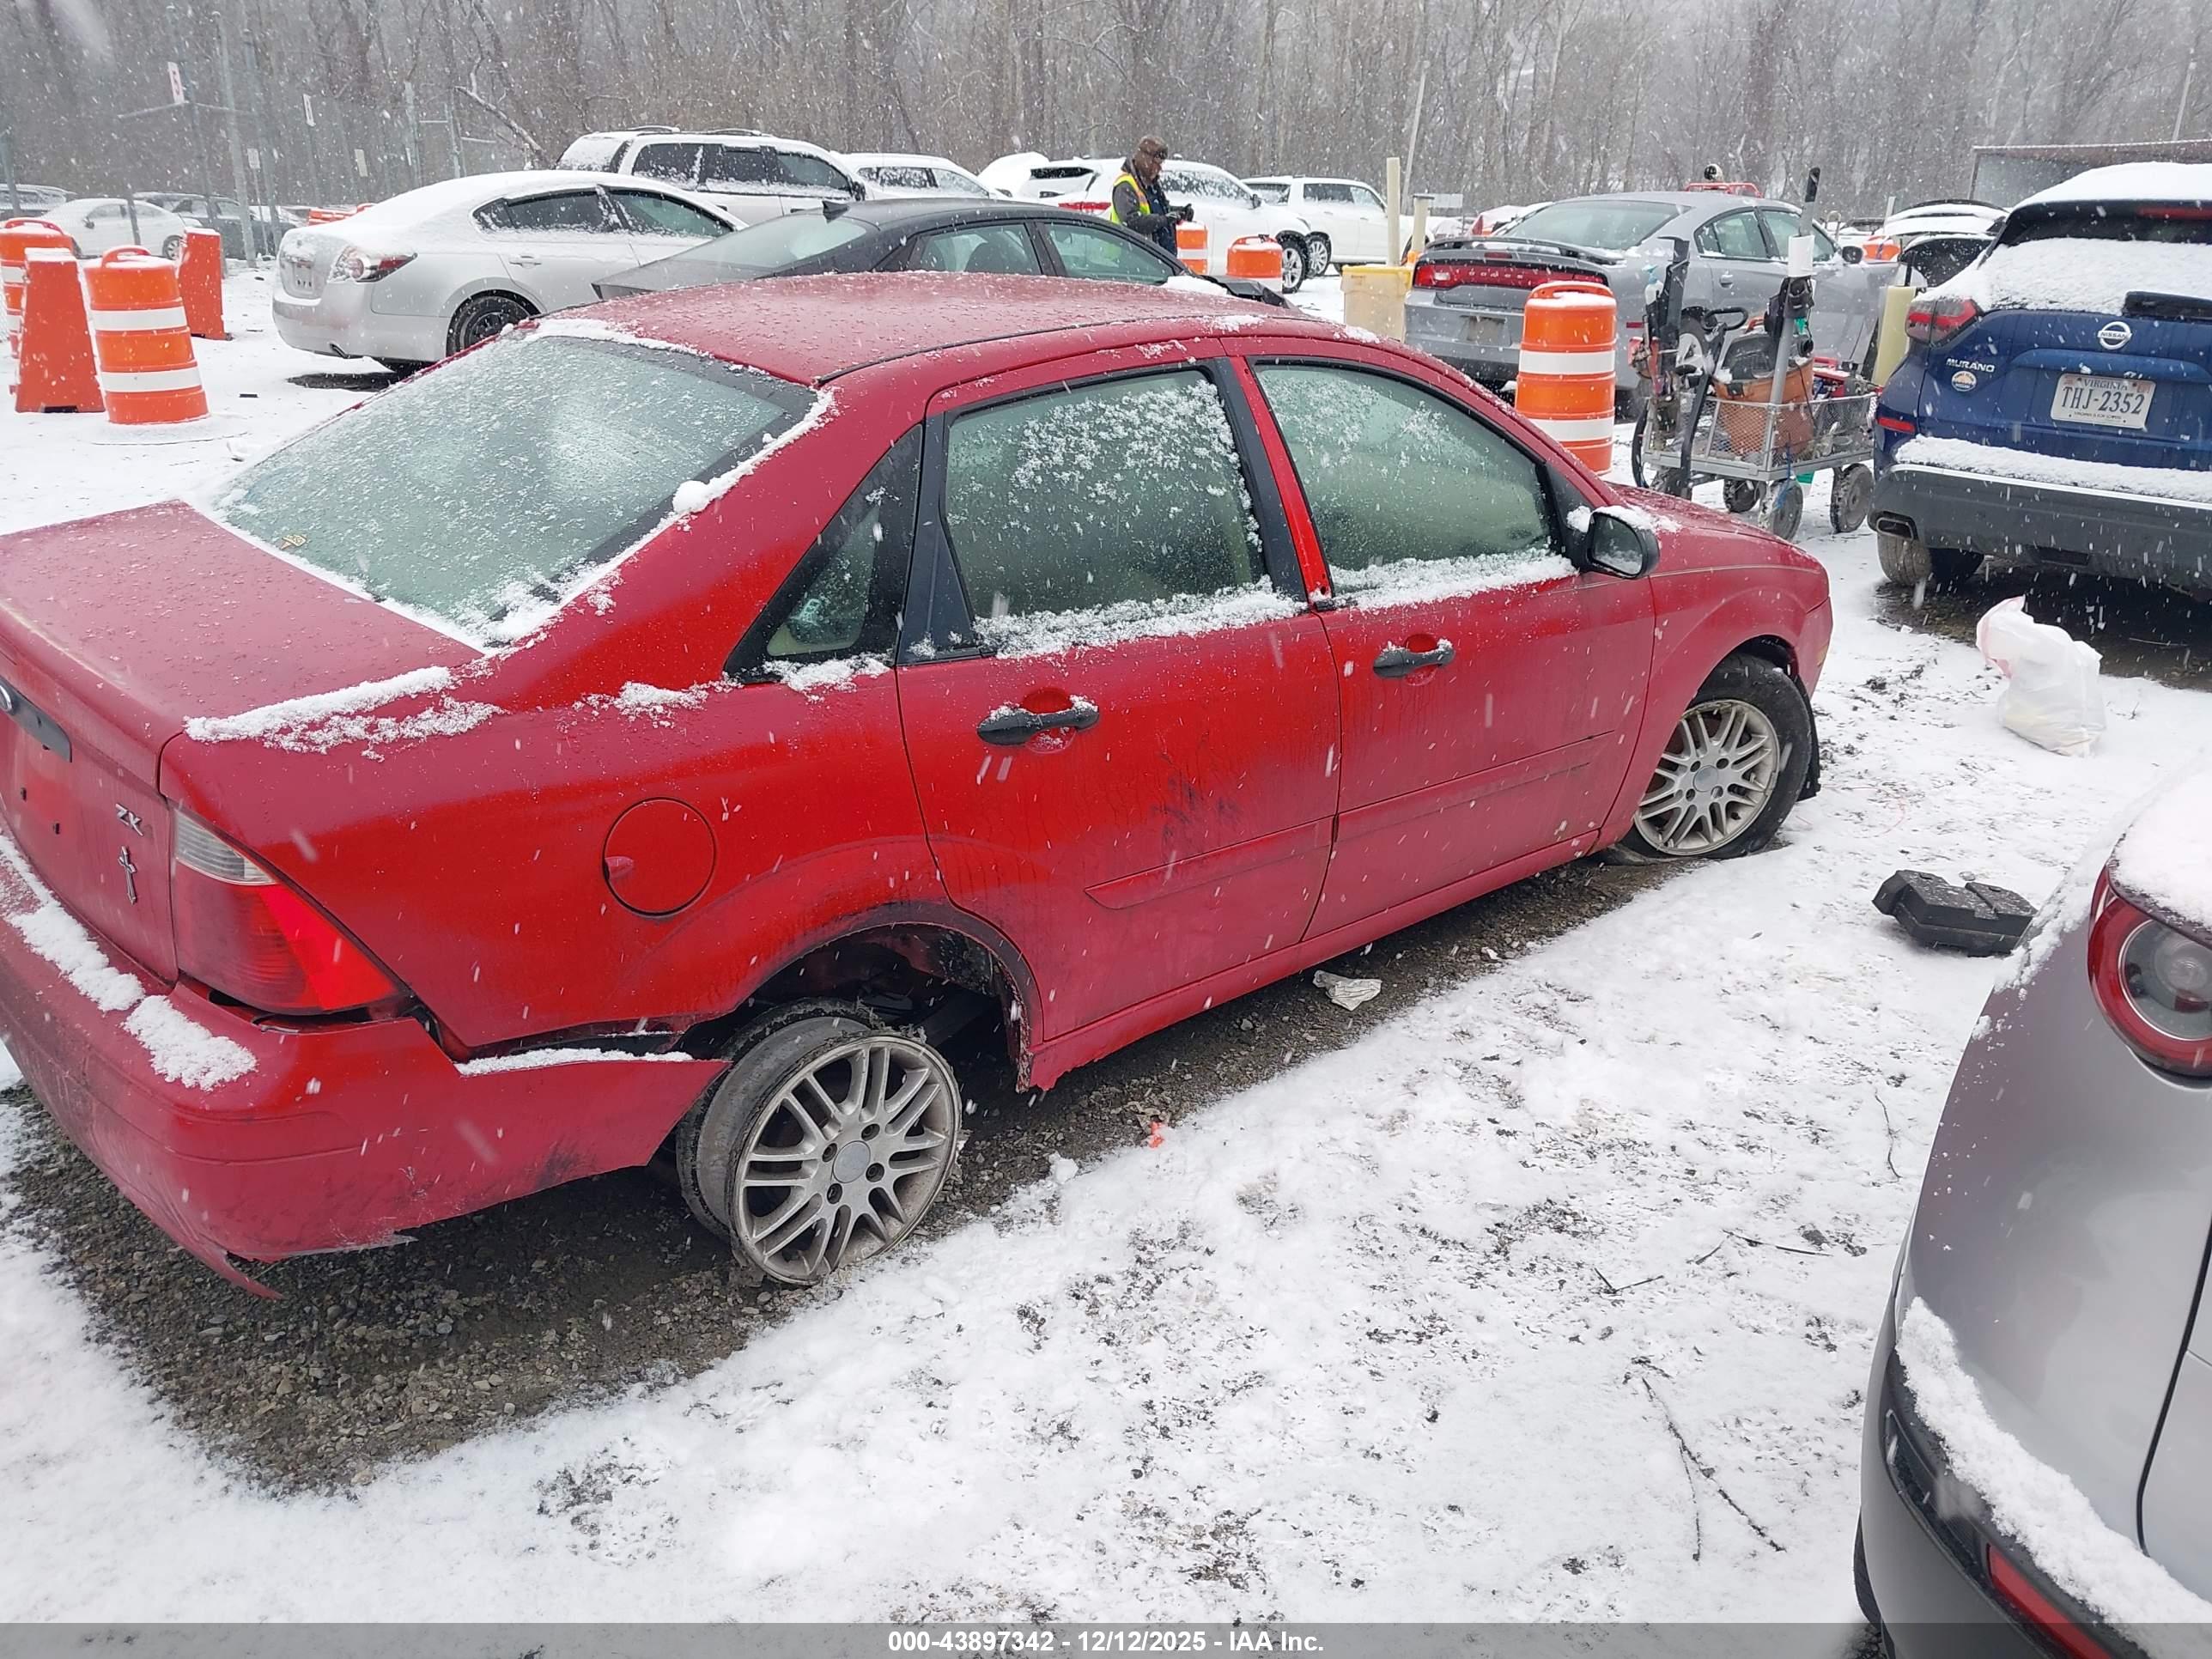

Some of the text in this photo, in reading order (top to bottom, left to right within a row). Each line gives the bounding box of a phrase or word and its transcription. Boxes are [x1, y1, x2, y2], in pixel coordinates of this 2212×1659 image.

[1946, 357, 1995, 373] MURANO
[2084, 379, 2128, 391] VIRGINIA
[2062, 386, 2145, 415] THJ-2352
